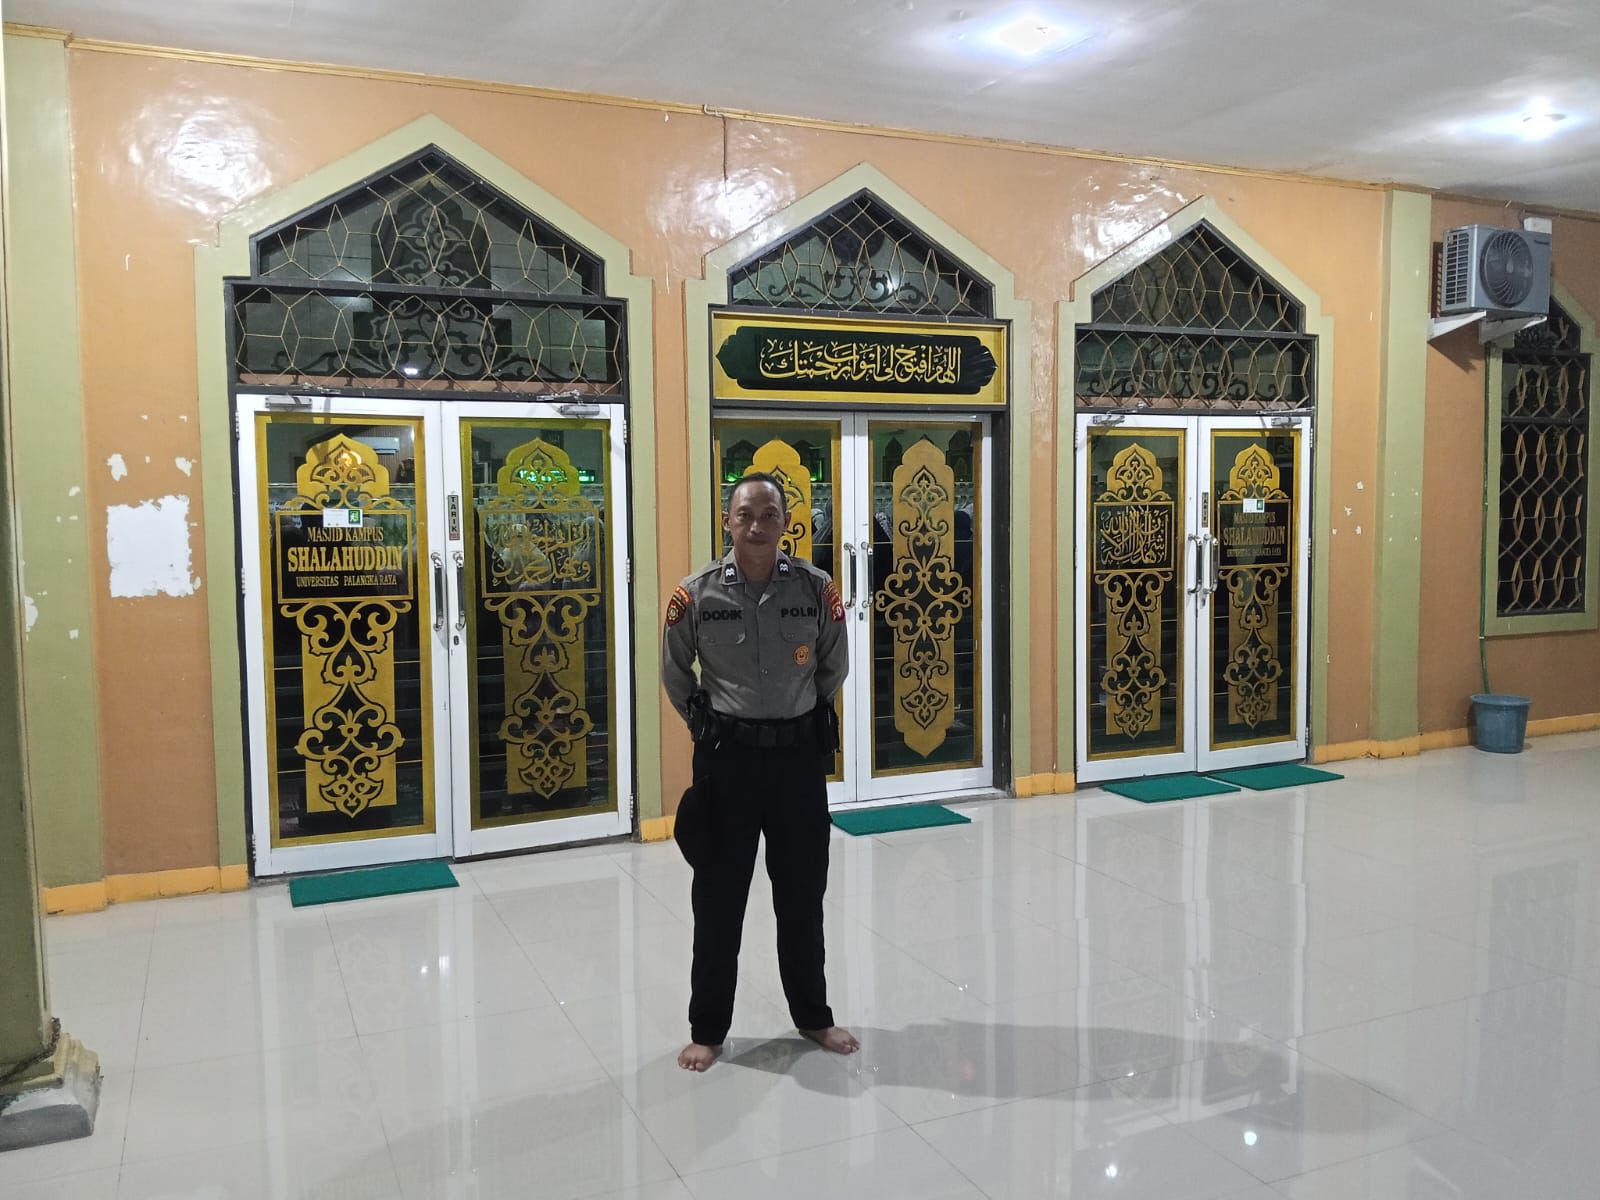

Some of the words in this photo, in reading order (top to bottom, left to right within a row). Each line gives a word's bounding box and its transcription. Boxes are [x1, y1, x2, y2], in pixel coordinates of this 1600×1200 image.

[450, 496, 458, 532] TARIK
[307, 526, 343, 543] MASJID
[345, 526, 384, 542] KAMPUS
[287, 545, 403, 572] SHALAHUDDIN
[296, 576, 339, 588] UNIVERSITAS
[378, 574, 397, 586] RAYA
[702, 609, 743, 621] DODIK
[780, 606, 818, 618] POLRI
